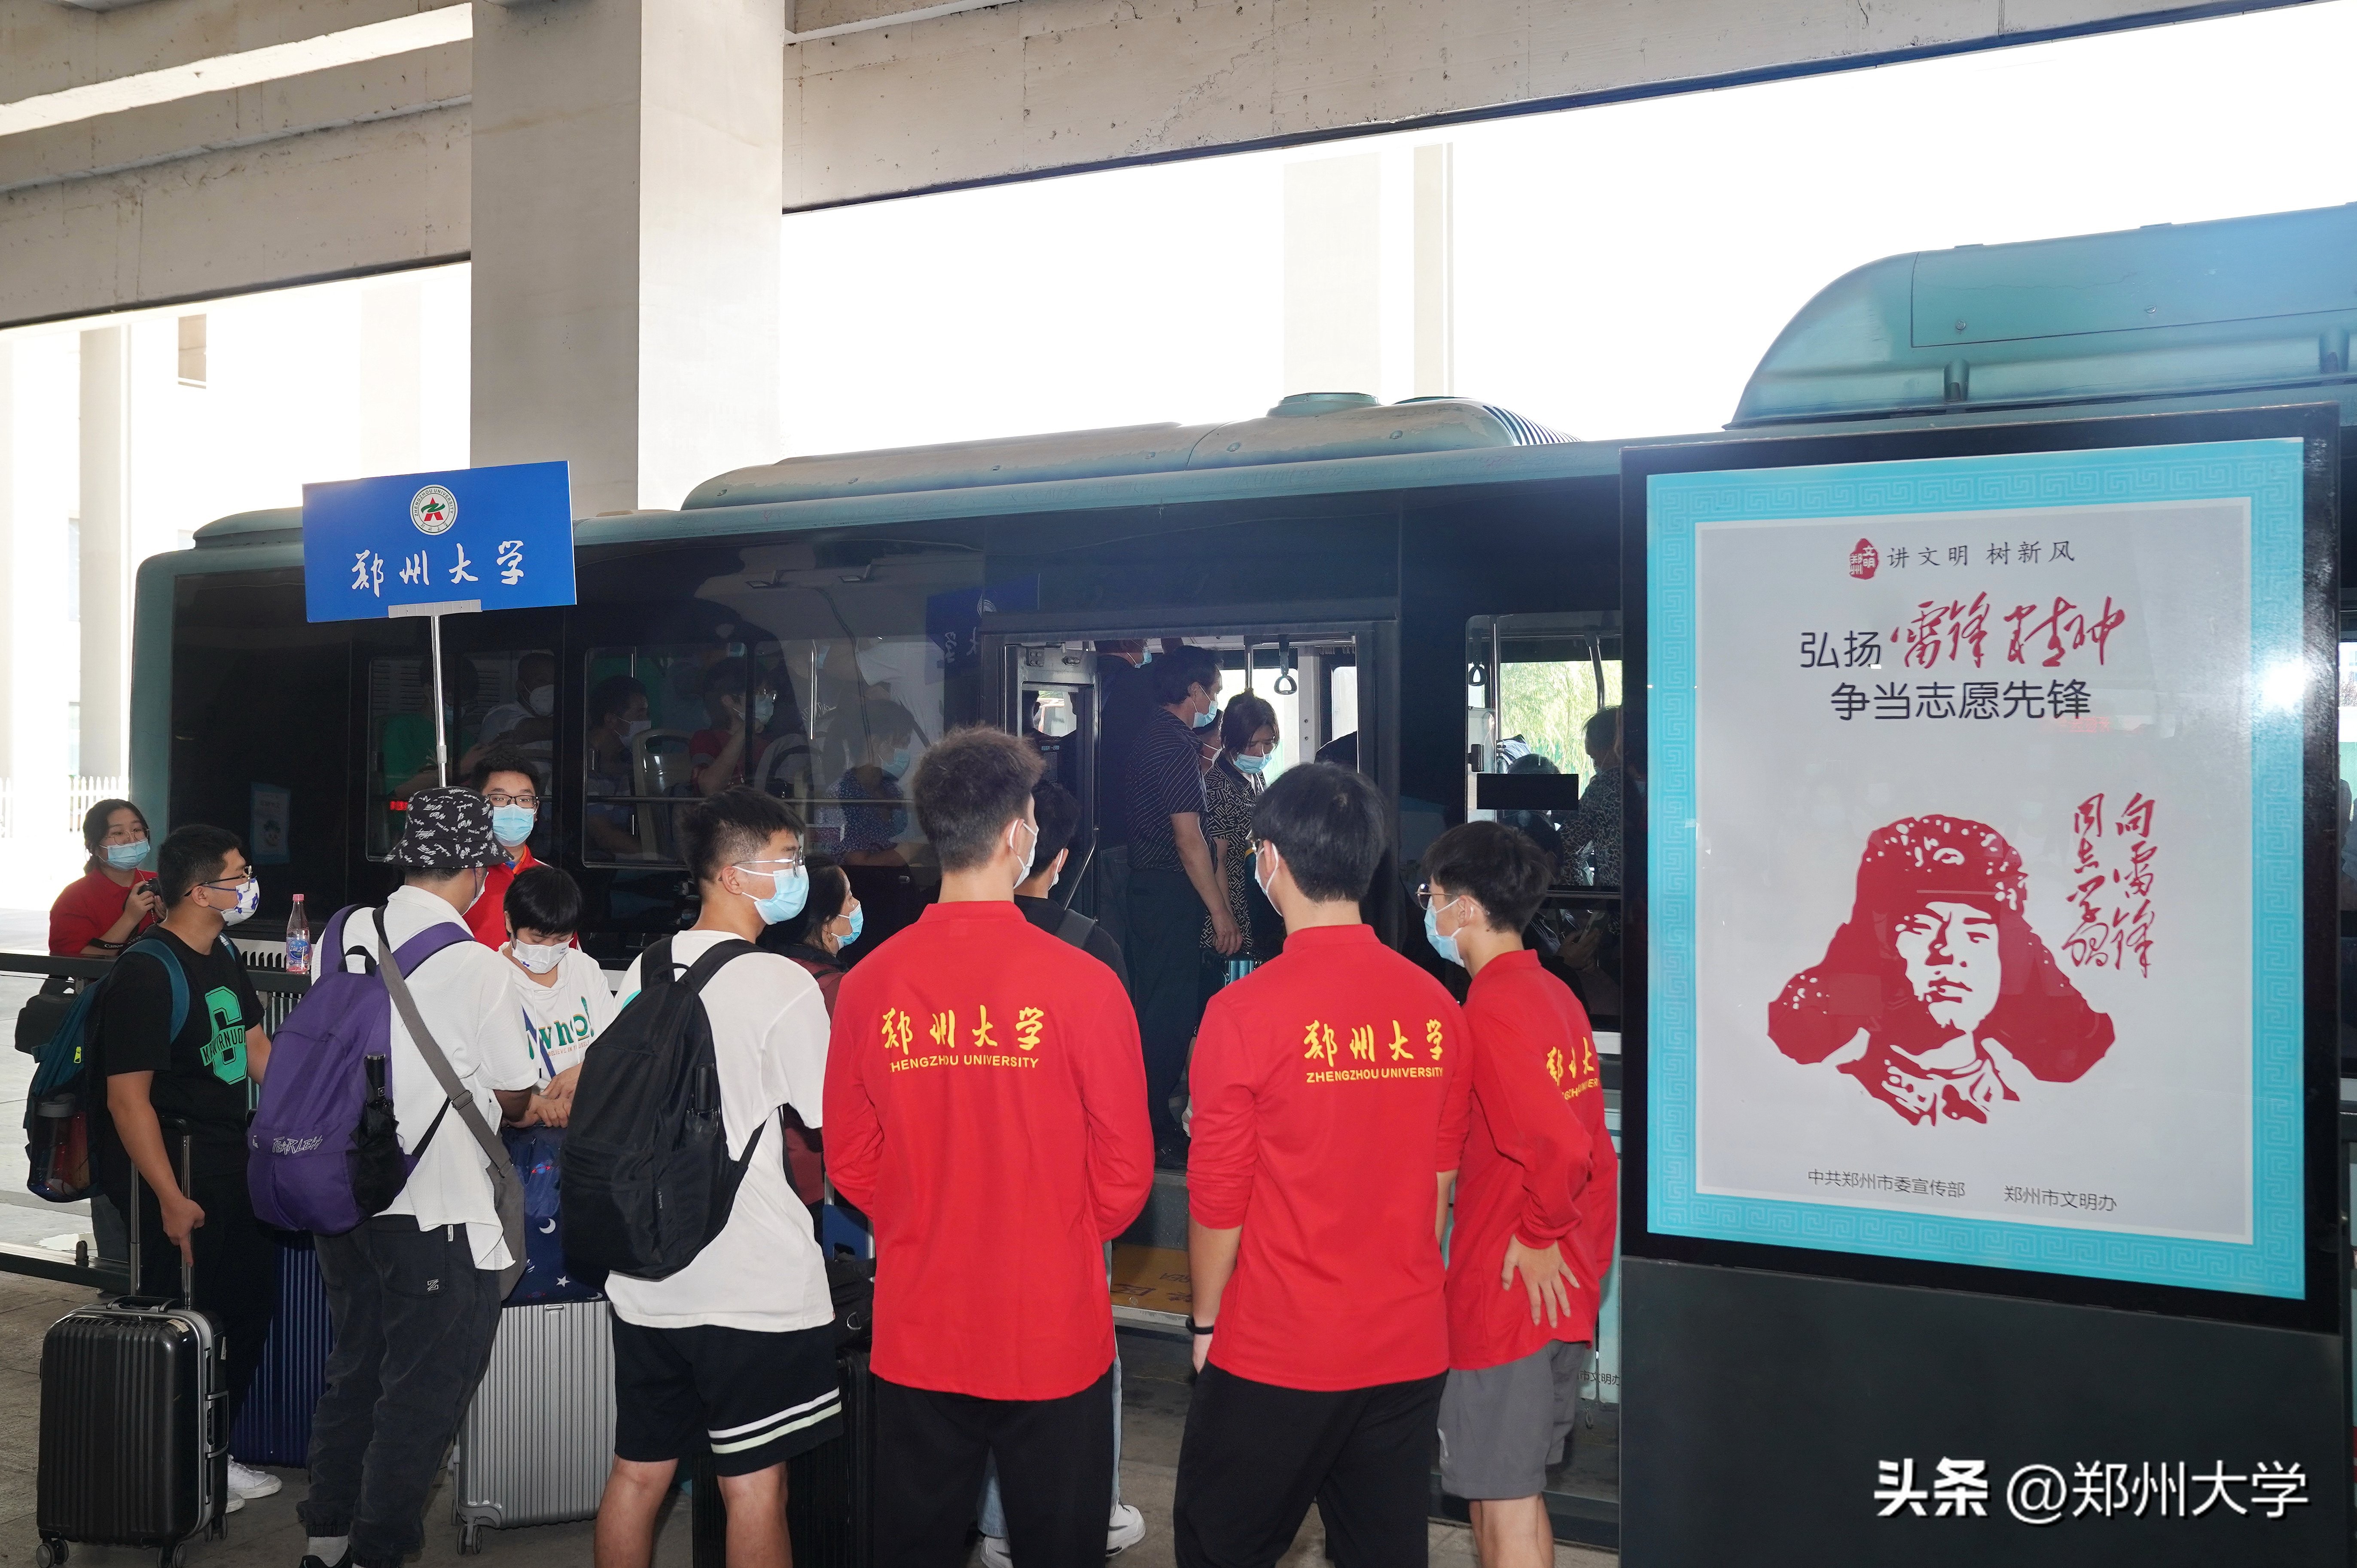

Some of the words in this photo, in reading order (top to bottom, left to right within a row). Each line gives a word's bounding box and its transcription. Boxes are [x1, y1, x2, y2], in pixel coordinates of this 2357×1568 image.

[415, 489, 432, 517] ZHENGZHOU
[434, 489, 454, 514] UNIVERSITY
[1886, 545, 1969, 568] 讲文明
[1986, 540, 2076, 565] 树新风
[351, 540, 524, 597] 郑州大学
[1830, 679, 2092, 721] 争当志愿先锋
[881, 1004, 1044, 1055] 郑州大学
[1303, 1019, 1443, 1067] 郑州大学
[890, 1055, 959, 1073] HENGZHOU
[964, 1054, 1039, 1069] UNIVERSITY
[1306, 1068, 1378, 1083] ZHENGZHOU
[1381, 1067, 1443, 1078] UNIVERSITY
[1808, 1168, 1966, 1198] 中共郑州市委宣传部
[2003, 1185, 2117, 1212] 郑州市文明办
[1577, 1370, 1620, 1386] 市文明办
